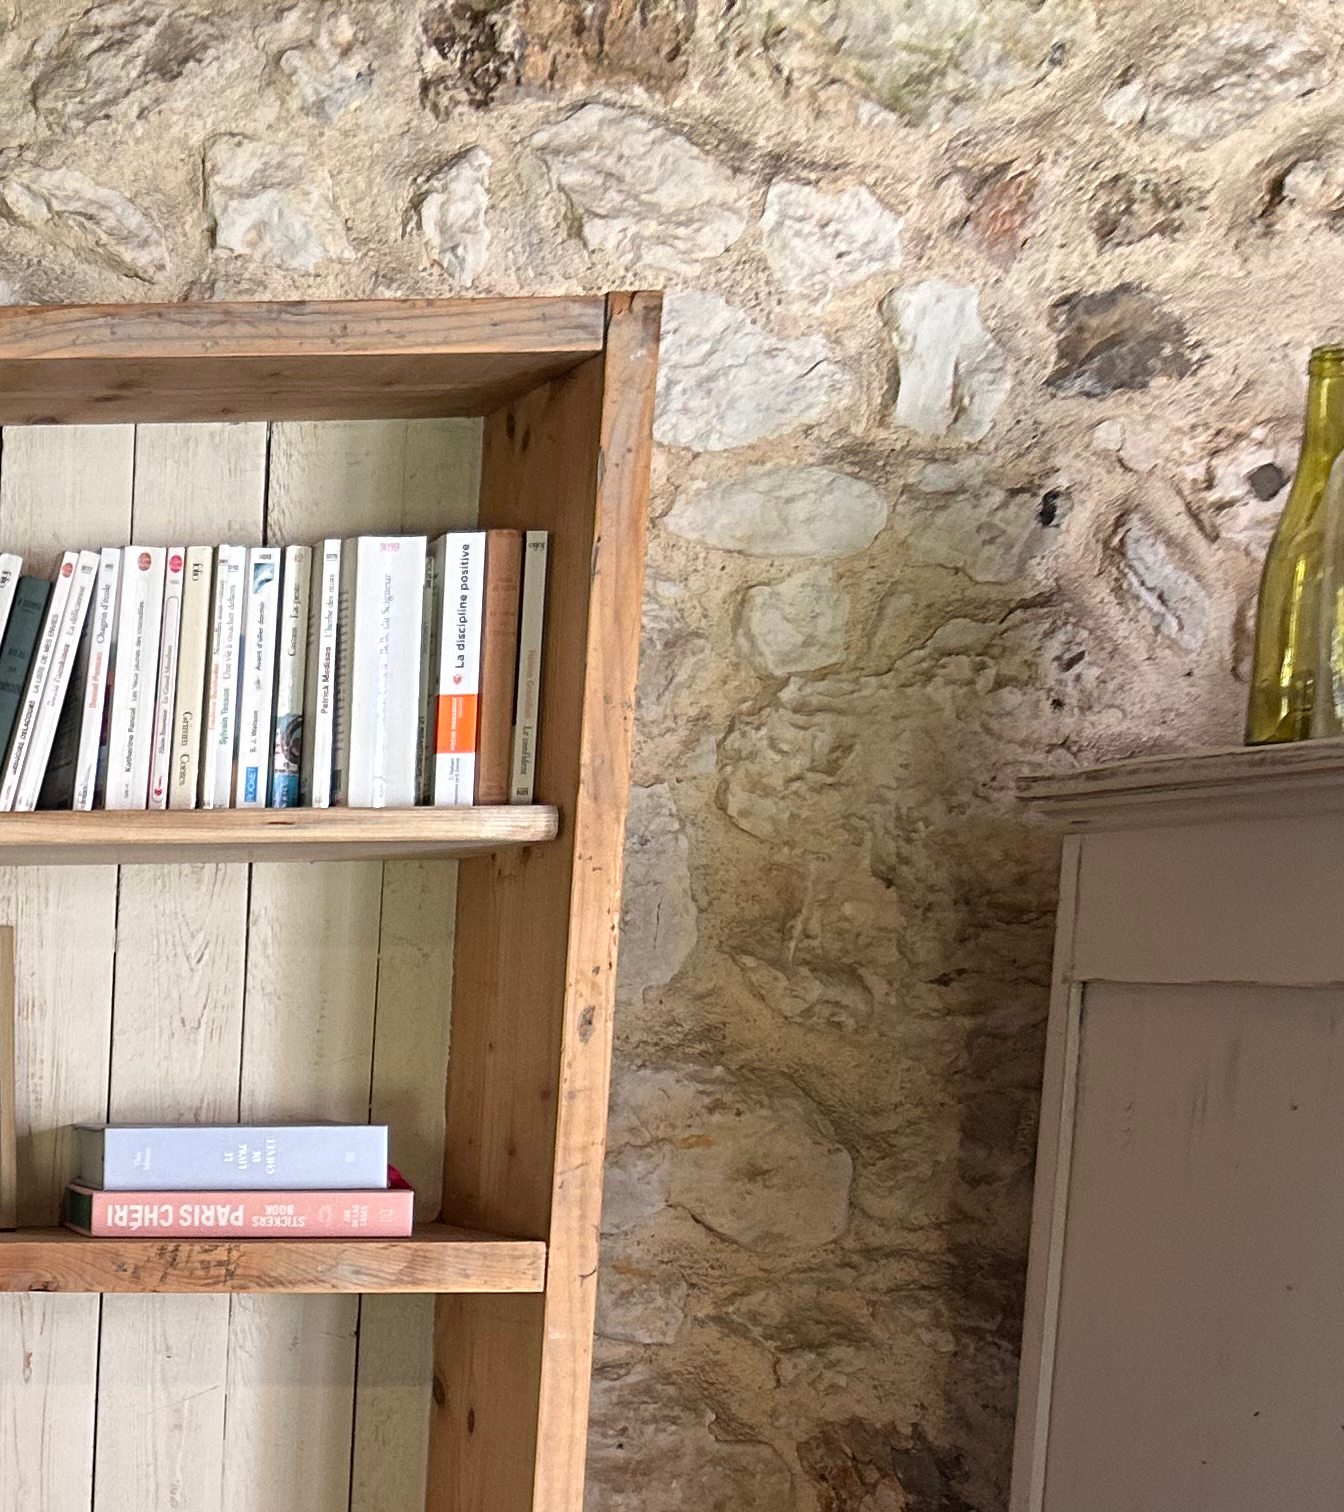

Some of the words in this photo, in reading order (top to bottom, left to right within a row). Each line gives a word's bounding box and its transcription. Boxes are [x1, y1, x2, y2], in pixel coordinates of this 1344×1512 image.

[458, 543, 471, 590] positive
[455, 594, 469, 650] discipline
[455, 654, 465, 668] La
[245, 766, 257, 801] POCKET
[107, 1204, 174, 1230] CHÉRI
[179, 1204, 244, 1227] PARIS
[251, 1215, 305, 1227] STICKERS
[264, 1204, 294, 1215] BOOK
